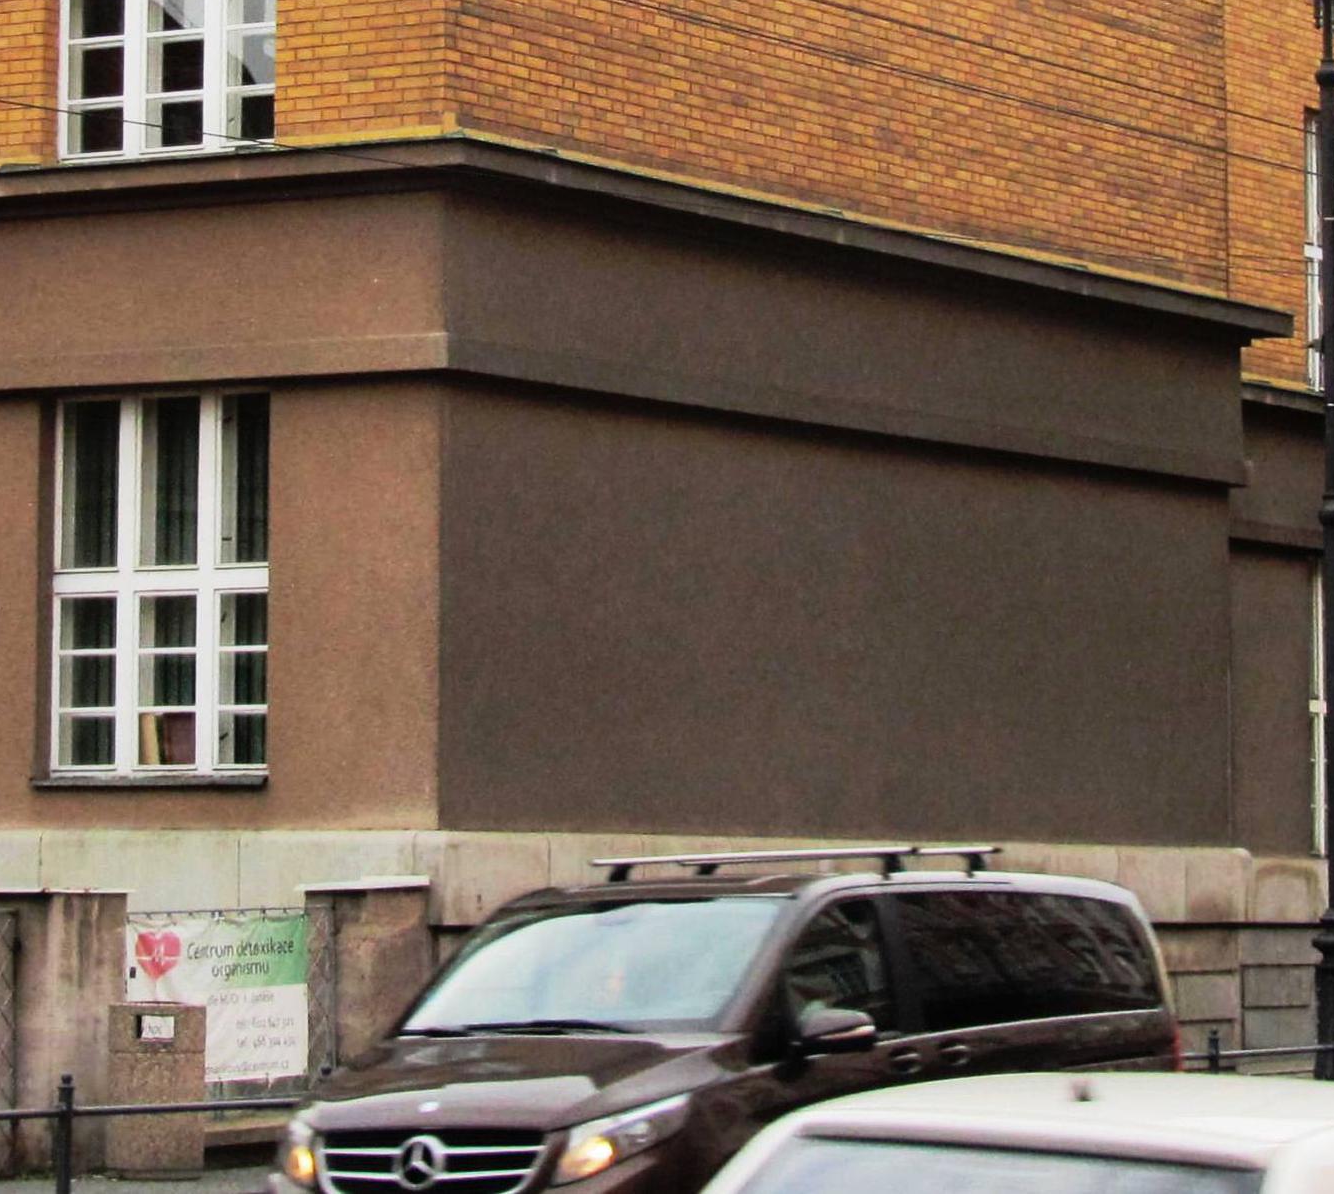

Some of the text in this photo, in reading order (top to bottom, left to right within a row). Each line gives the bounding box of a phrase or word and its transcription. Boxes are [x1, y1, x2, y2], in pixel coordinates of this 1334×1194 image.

[187, 937, 294, 959] Centrum detoxikace
[212, 960, 270, 981] organismu
